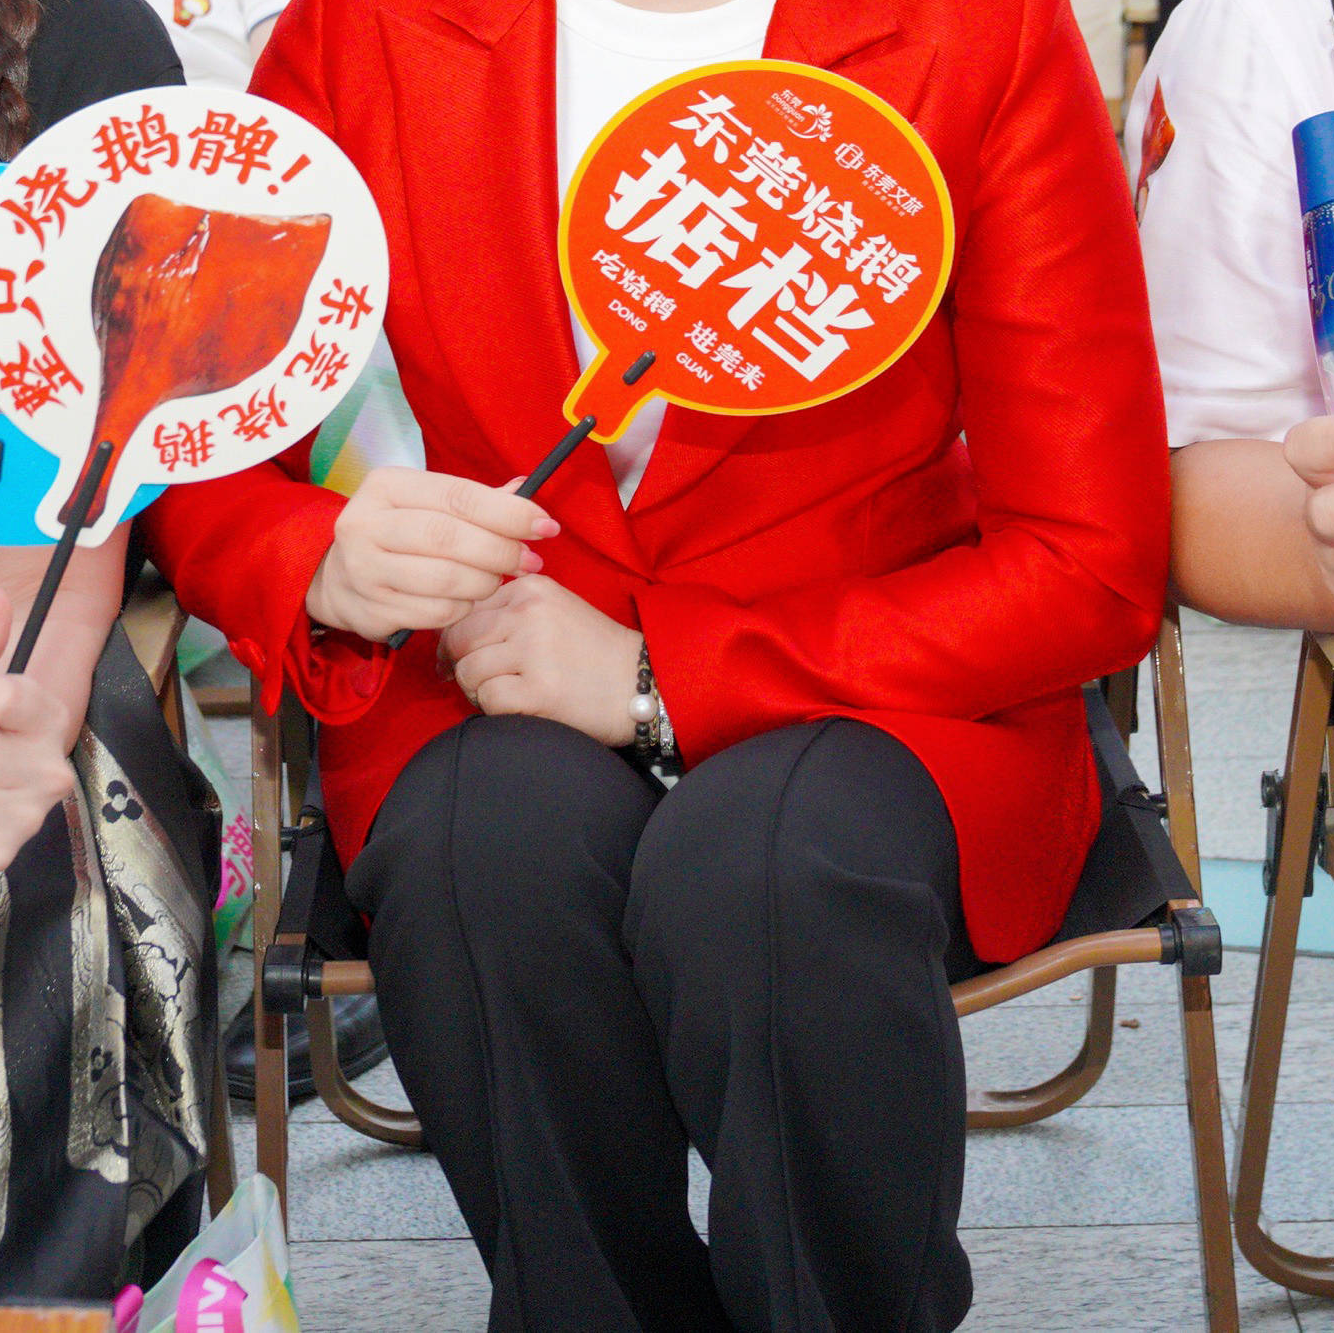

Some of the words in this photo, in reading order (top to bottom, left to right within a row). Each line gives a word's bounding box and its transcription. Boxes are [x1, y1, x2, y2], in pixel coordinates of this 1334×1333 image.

[603, 141, 876, 383] 掂档
[668, 89, 923, 305] 东莞烧鹅
[861, 163, 925, 216] 东莞文旅
[152, 276, 376, 473] 东莞烧鹅
[590, 249, 678, 322] 吃烧鹅
[683, 319, 766, 392] 进莞来
[607, 298, 649, 333] DONG
[675, 351, 714, 384] GUAN
